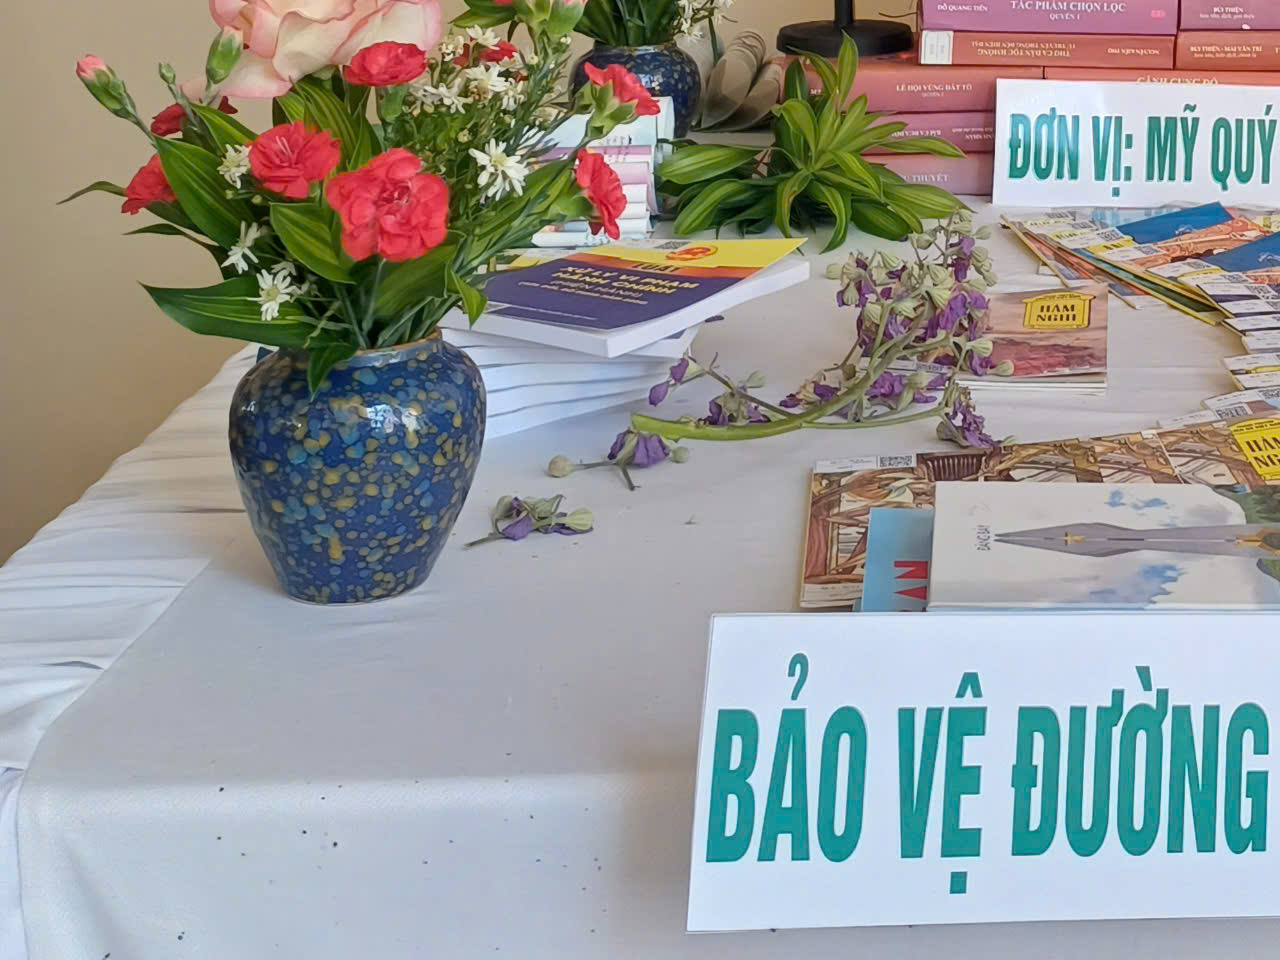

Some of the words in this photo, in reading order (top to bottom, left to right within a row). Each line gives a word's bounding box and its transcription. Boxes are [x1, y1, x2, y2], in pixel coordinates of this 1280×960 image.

[948, 4, 972, 12] QUANG
[1069, 1, 1101, 13] CHỌN
[1103, 1, 1126, 13] LỌC
[1008, 107, 1080, 180] ĐƠN
[1091, 115, 1133, 197] VỊ:
[1145, 103, 1200, 182] MỸ
[1211, 104, 1278, 191] QUÝ
[705, 652, 868, 863] BẢO
[898, 671, 988, 895] VỆ
[1010, 665, 1270, 858] ĐƯỜNG
